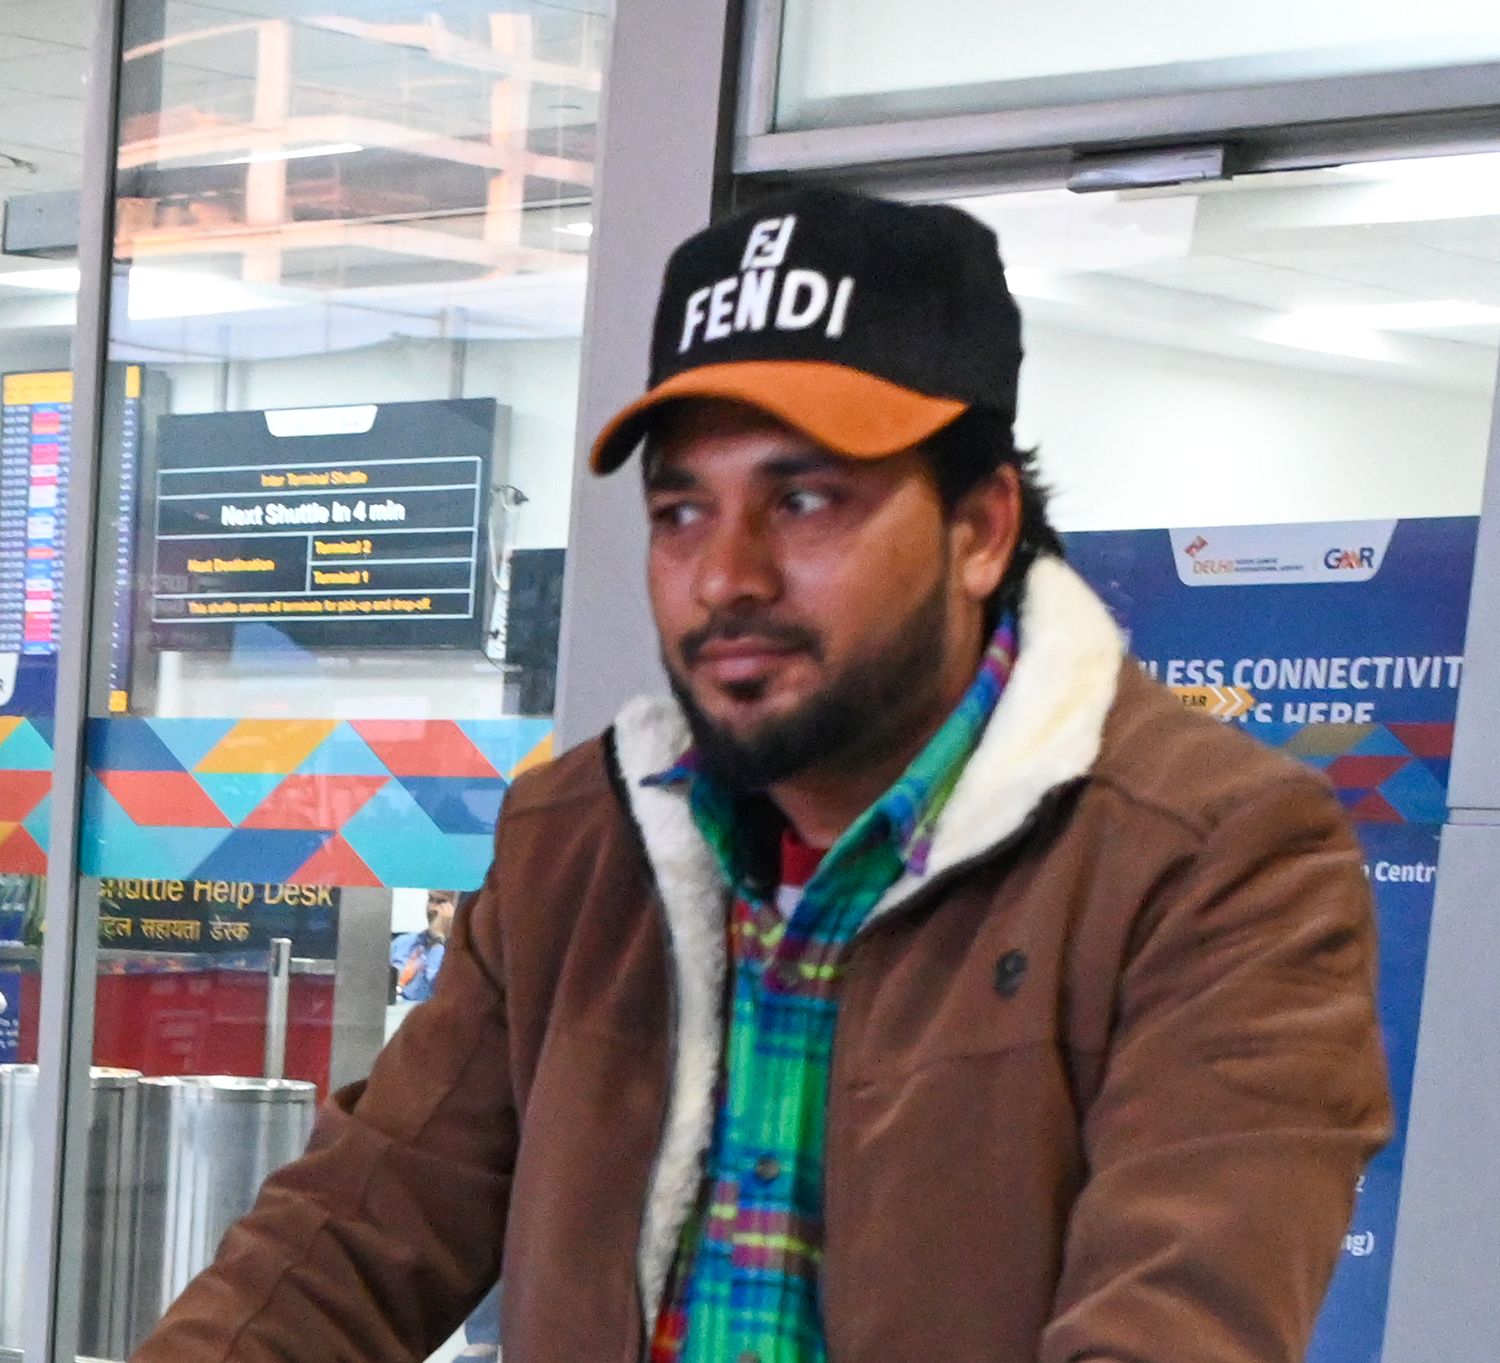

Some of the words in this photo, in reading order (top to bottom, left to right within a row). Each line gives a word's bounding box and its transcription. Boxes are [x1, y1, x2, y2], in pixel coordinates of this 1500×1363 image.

[678, 267, 856, 354] FENDI
[221, 504, 263, 526] Next
[265, 502, 330, 525] Shuttle
[353, 500, 367, 522] 4
[369, 499, 406, 521] min
[1233, 656, 1464, 690] CONNECTIVIT
[1375, 861, 1437, 883] Centr
[194, 879, 255, 909] Help
